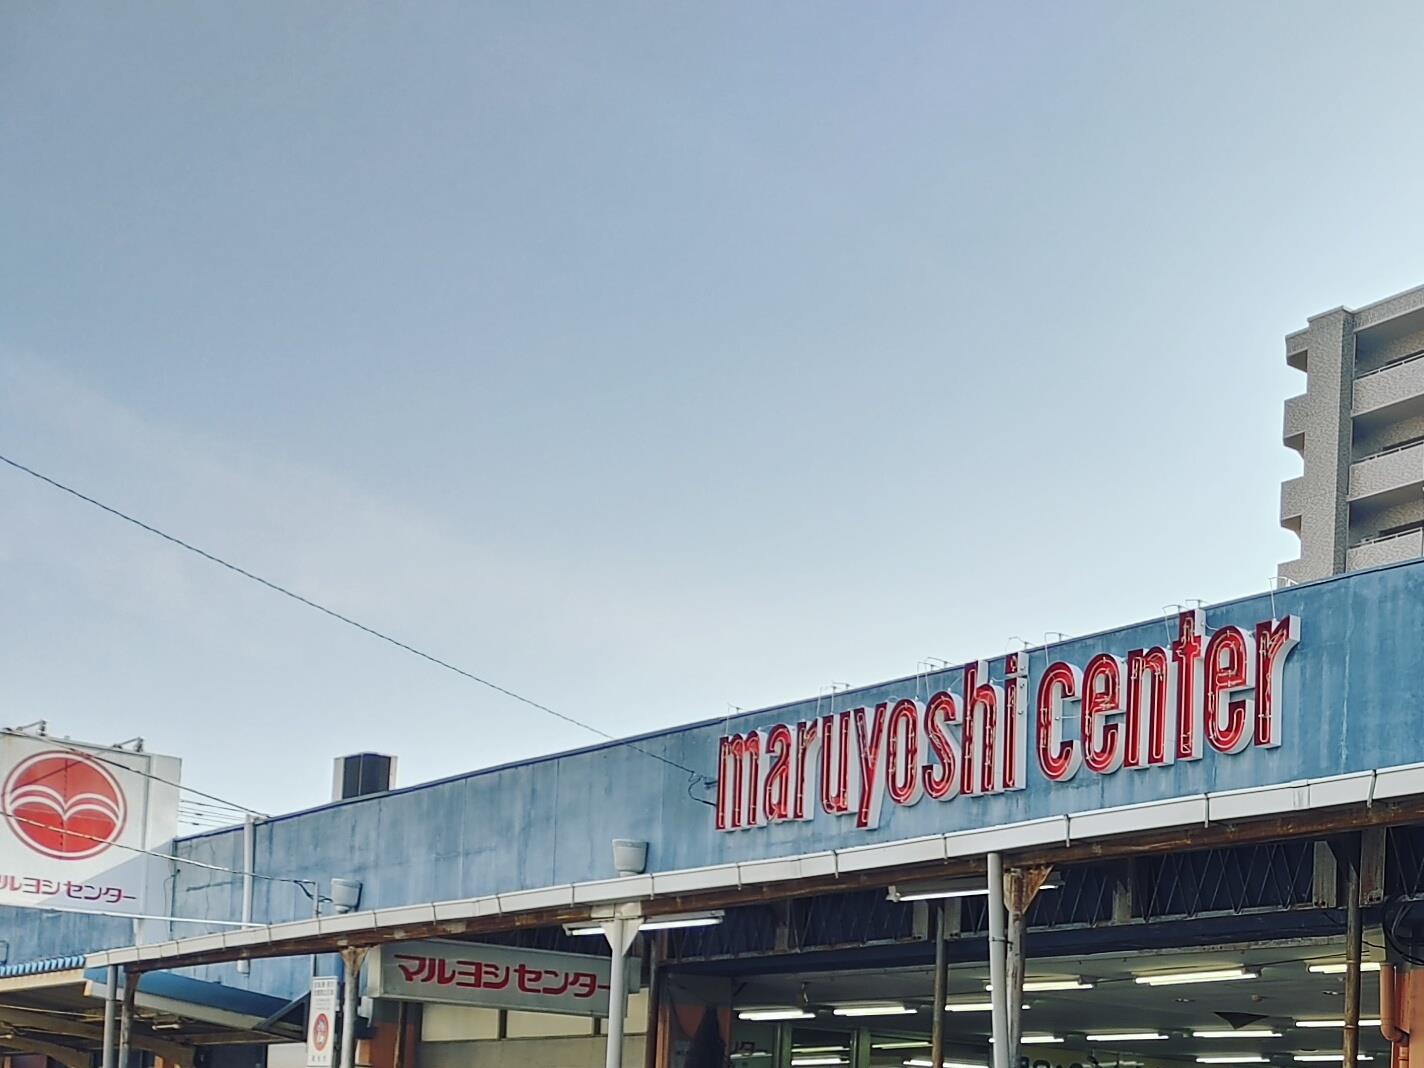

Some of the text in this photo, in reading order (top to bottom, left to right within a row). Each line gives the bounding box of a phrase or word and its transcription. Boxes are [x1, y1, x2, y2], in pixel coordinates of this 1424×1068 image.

[715, 609, 1299, 831] maruyoshi center
[0, 875, 137, 903] ルヨシセンター
[394, 954, 611, 998] マルヨシセンター
